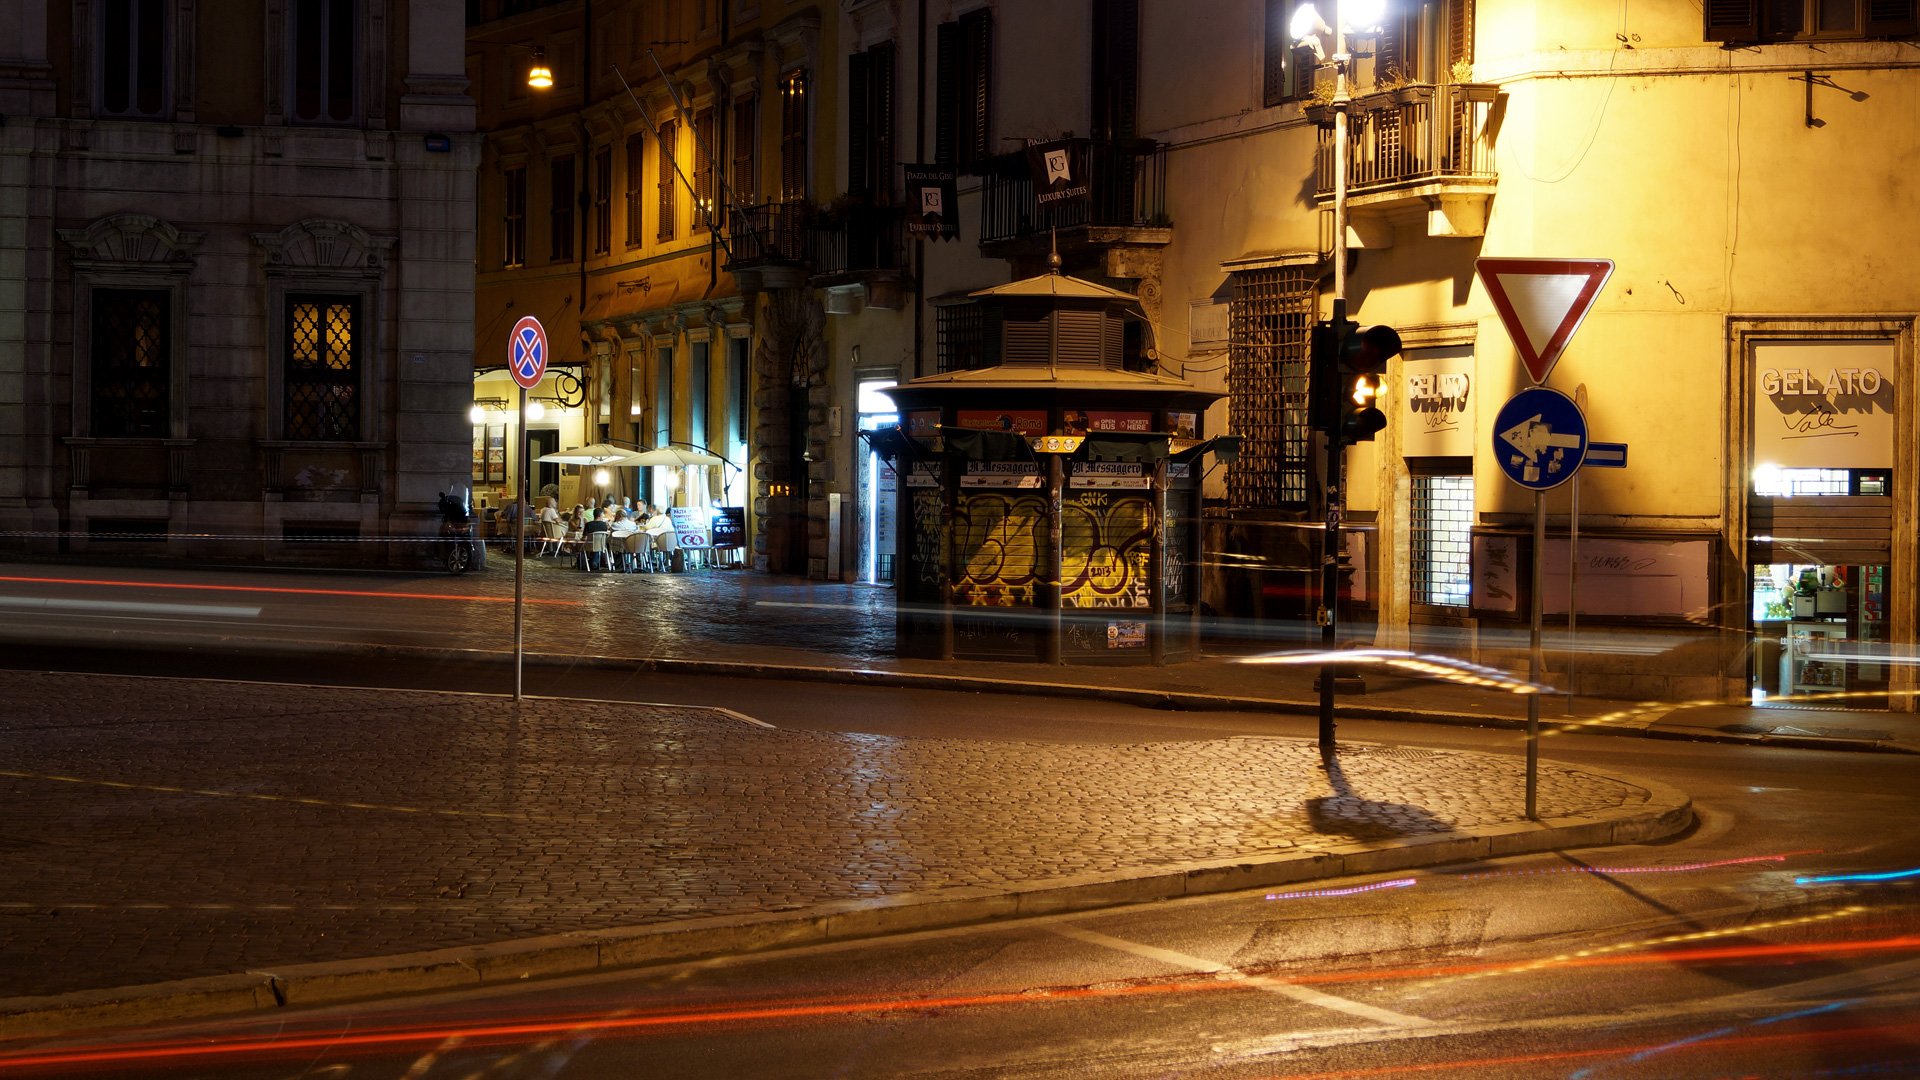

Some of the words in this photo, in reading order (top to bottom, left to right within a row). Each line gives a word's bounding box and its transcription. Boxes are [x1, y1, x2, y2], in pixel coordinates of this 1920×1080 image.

[906, 171, 927, 181] PIAZZA
[1038, 190, 1066, 204] LUXURY
[1066, 185, 1087, 198] SUITES
[909, 222, 936, 232] LUXURY
[1760, 367, 1882, 396] GELATO
[1015, 416, 1043, 430] Roma
[980, 460, 1038, 474] Messaggero
[1086, 463, 1141, 475] Messaggero
